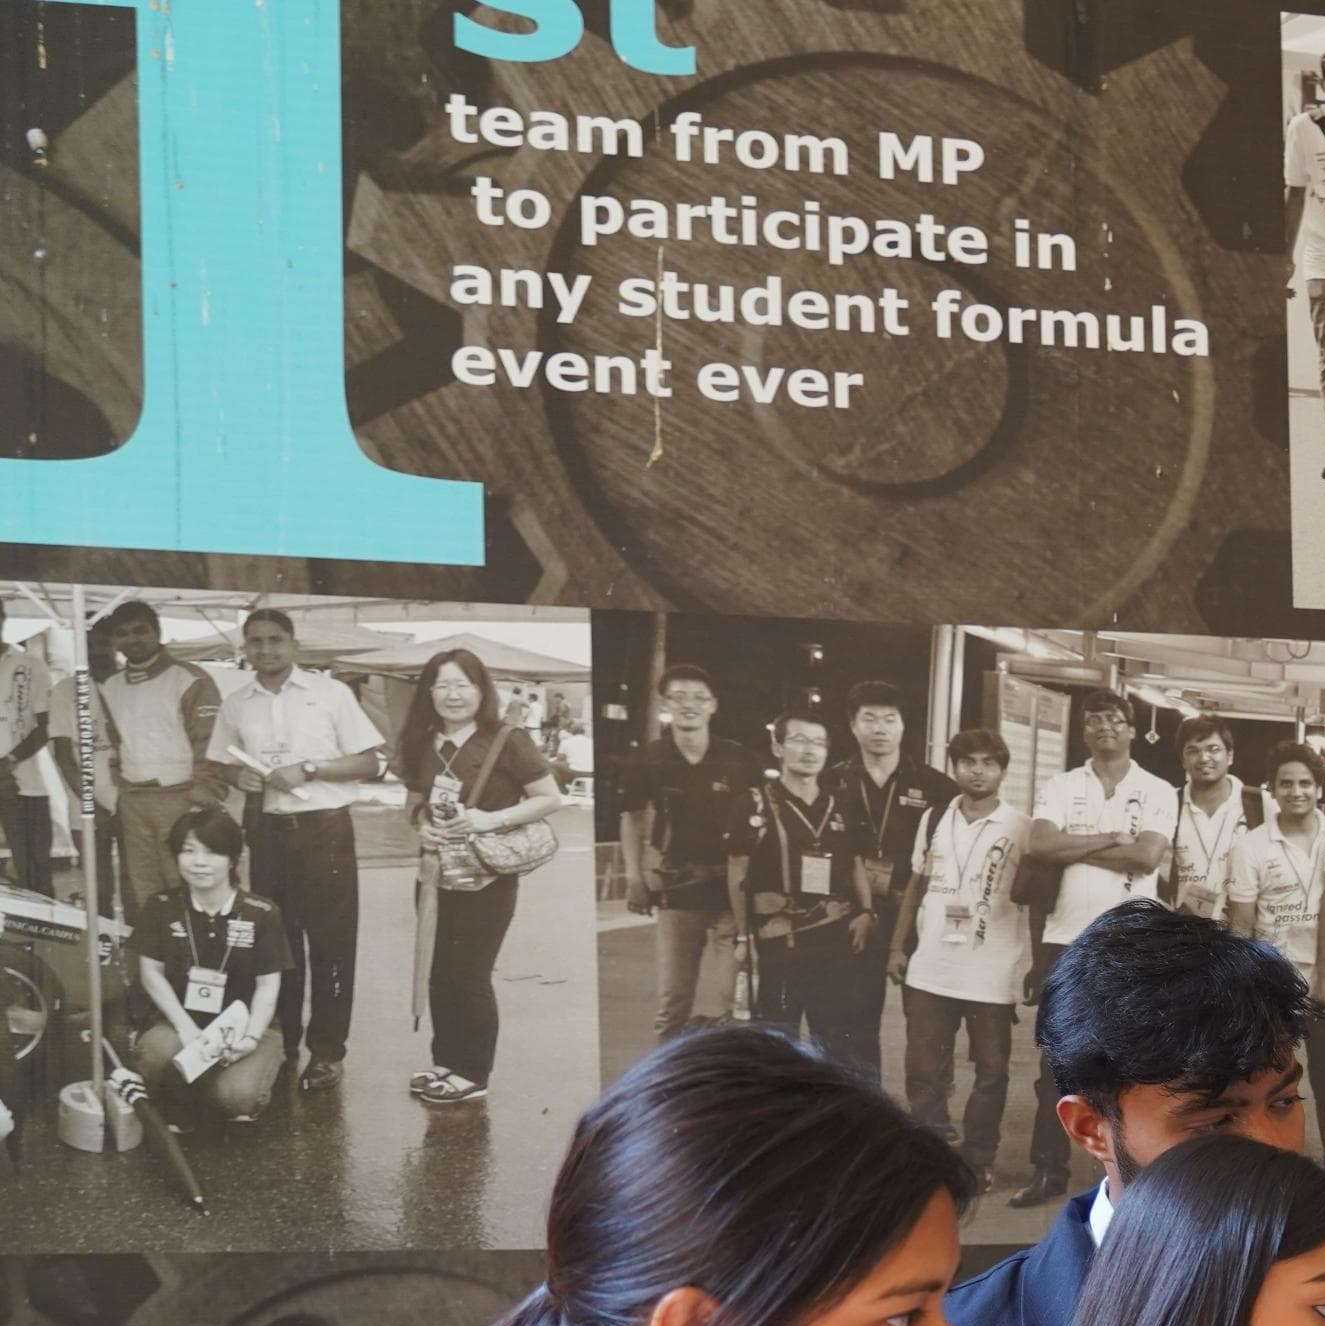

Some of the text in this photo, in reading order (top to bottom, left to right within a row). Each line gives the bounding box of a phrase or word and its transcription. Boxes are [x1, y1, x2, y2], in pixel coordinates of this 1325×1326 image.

[446, 94, 984, 185] team from MP
[472, 176, 1076, 271] to participate in
[450, 264, 1210, 357] any student formula
[452, 337, 864, 409] event ever
